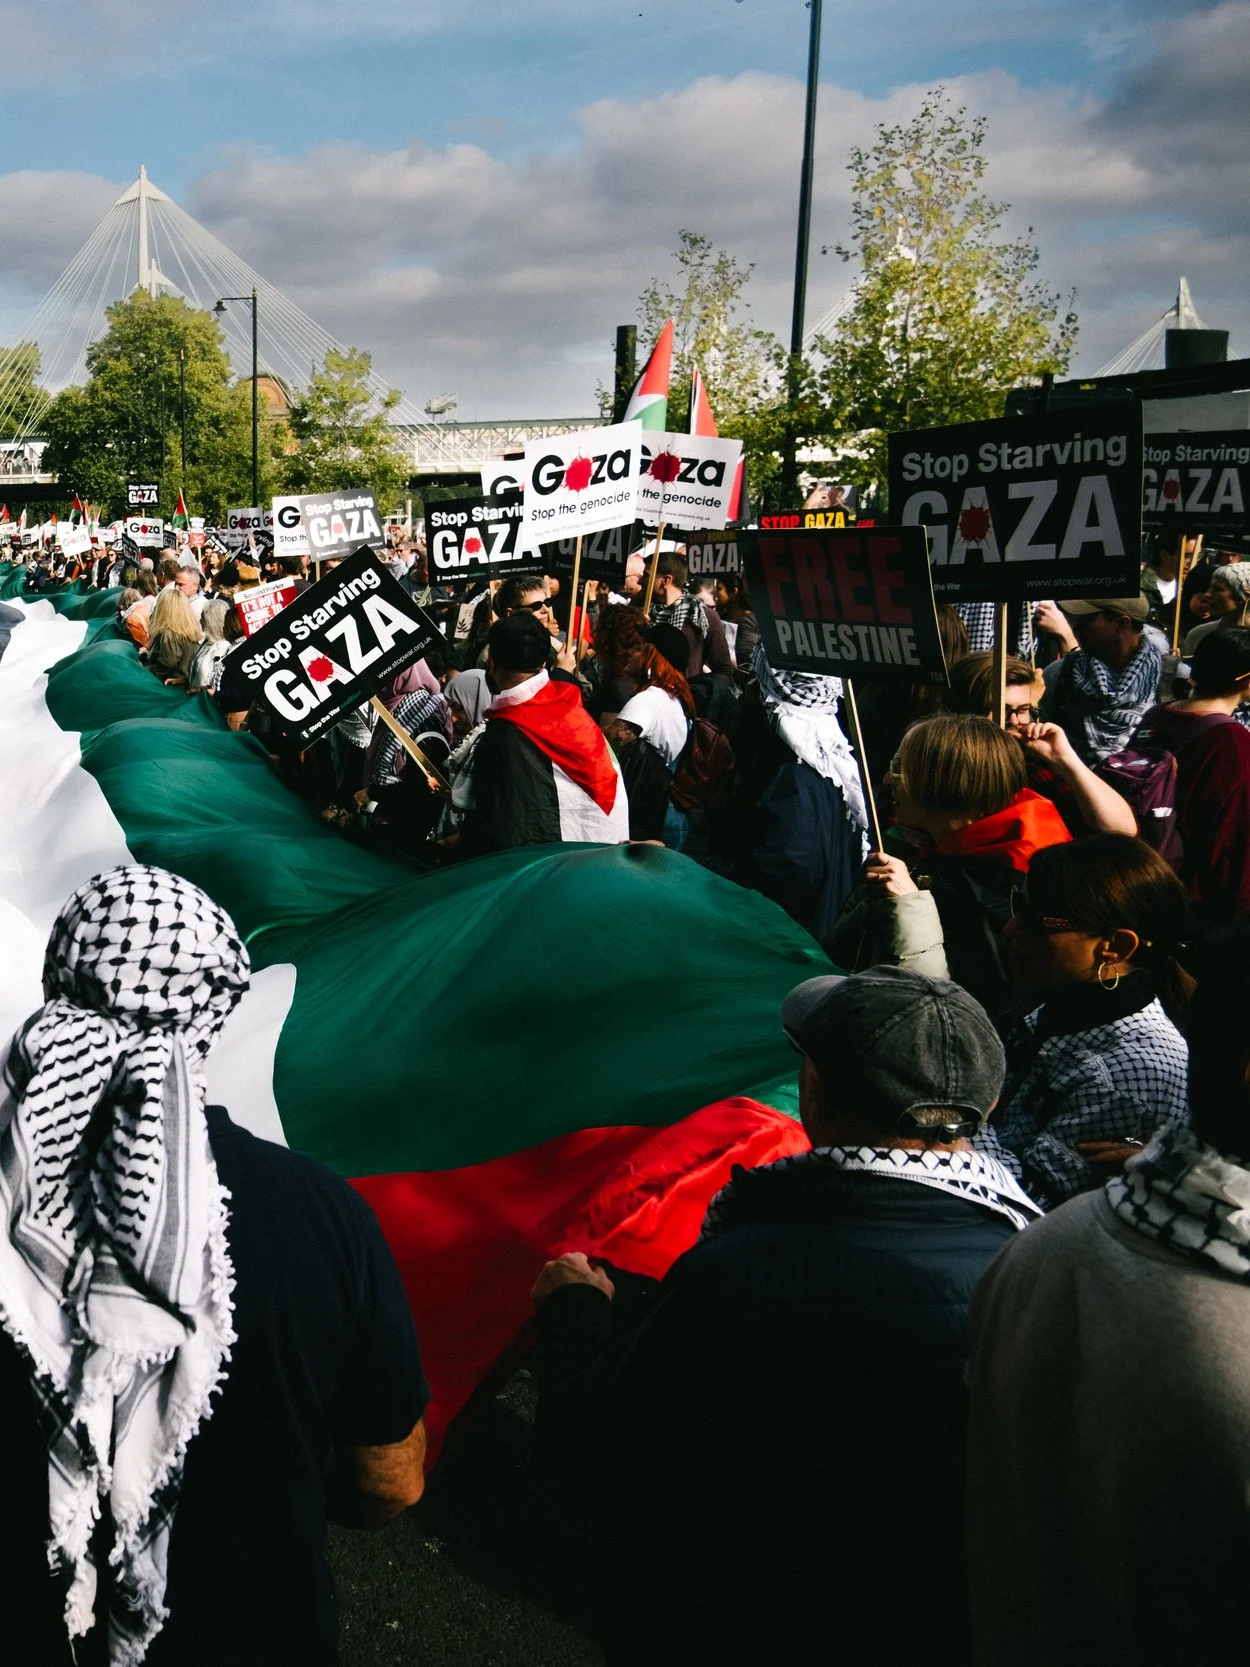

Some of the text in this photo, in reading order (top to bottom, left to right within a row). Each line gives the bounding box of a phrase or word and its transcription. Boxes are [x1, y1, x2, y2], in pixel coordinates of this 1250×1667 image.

[641, 444, 725, 487] za
[902, 433, 1127, 482] Stop Starving
[1143, 444, 1250, 466] Stop Starving
[532, 448, 631, 496] Gza
[129, 490, 158, 503] GAZA
[643, 488, 721, 509] the genocide
[1143, 468, 1244, 513] GAZA
[305, 496, 374, 516] Stop Starving
[431, 504, 524, 527] Stop Starvi
[531, 490, 631, 521] Stop the genocide
[760, 515, 800, 528] STOP
[805, 511, 845, 528] GAZA
[901, 474, 1125, 565] GAZA
[130, 523, 160, 534] Gza
[230, 515, 260, 529] Gza
[310, 509, 380, 547] GAZA
[62, 534, 86, 547] Gza
[254, 534, 274, 547] rving
[433, 522, 542, 569] GAZA
[558, 527, 622, 563] ZA
[689, 542, 739, 574] GAZA
[758, 536, 912, 624] FREE
[947, 582, 961, 590] War
[1026, 575, 1127, 588] www.stopwar.org.uk
[241, 591, 284, 613] IT'S NOT A
[244, 607, 271, 624] CRIME
[241, 567, 381, 680] Stop Starving
[775, 619, 921, 666] PALESTINE
[264, 594, 420, 722] GAZA
[377, 636, 433, 679] www.stopwar.org.uk
[309, 721, 322, 733] Stop
[320, 714, 330, 723] the
[329, 706, 340, 716] War
